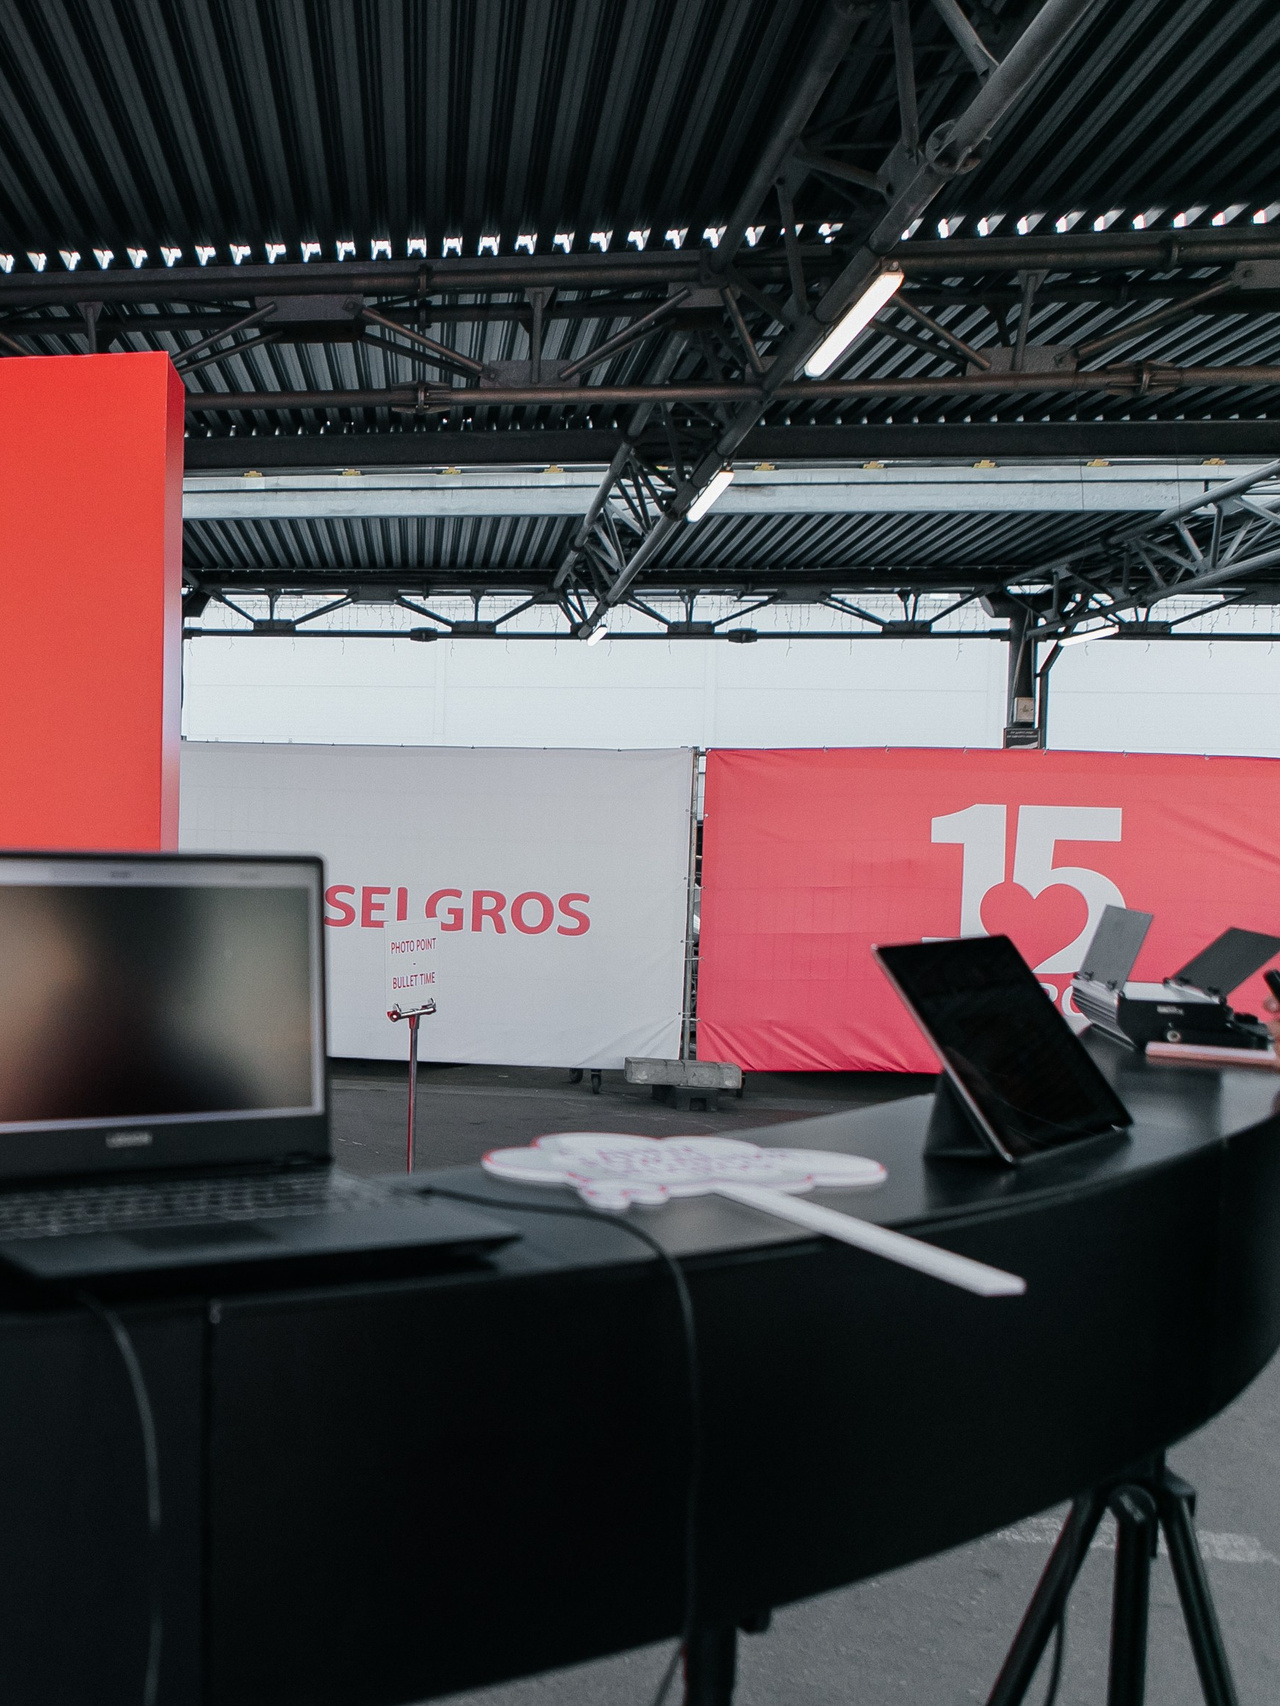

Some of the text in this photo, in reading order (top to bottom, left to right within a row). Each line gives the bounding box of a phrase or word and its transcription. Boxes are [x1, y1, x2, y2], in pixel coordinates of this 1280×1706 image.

[390, 937, 437, 954] PHOTO POINT
[392, 971, 436, 990] BULLET TIME
